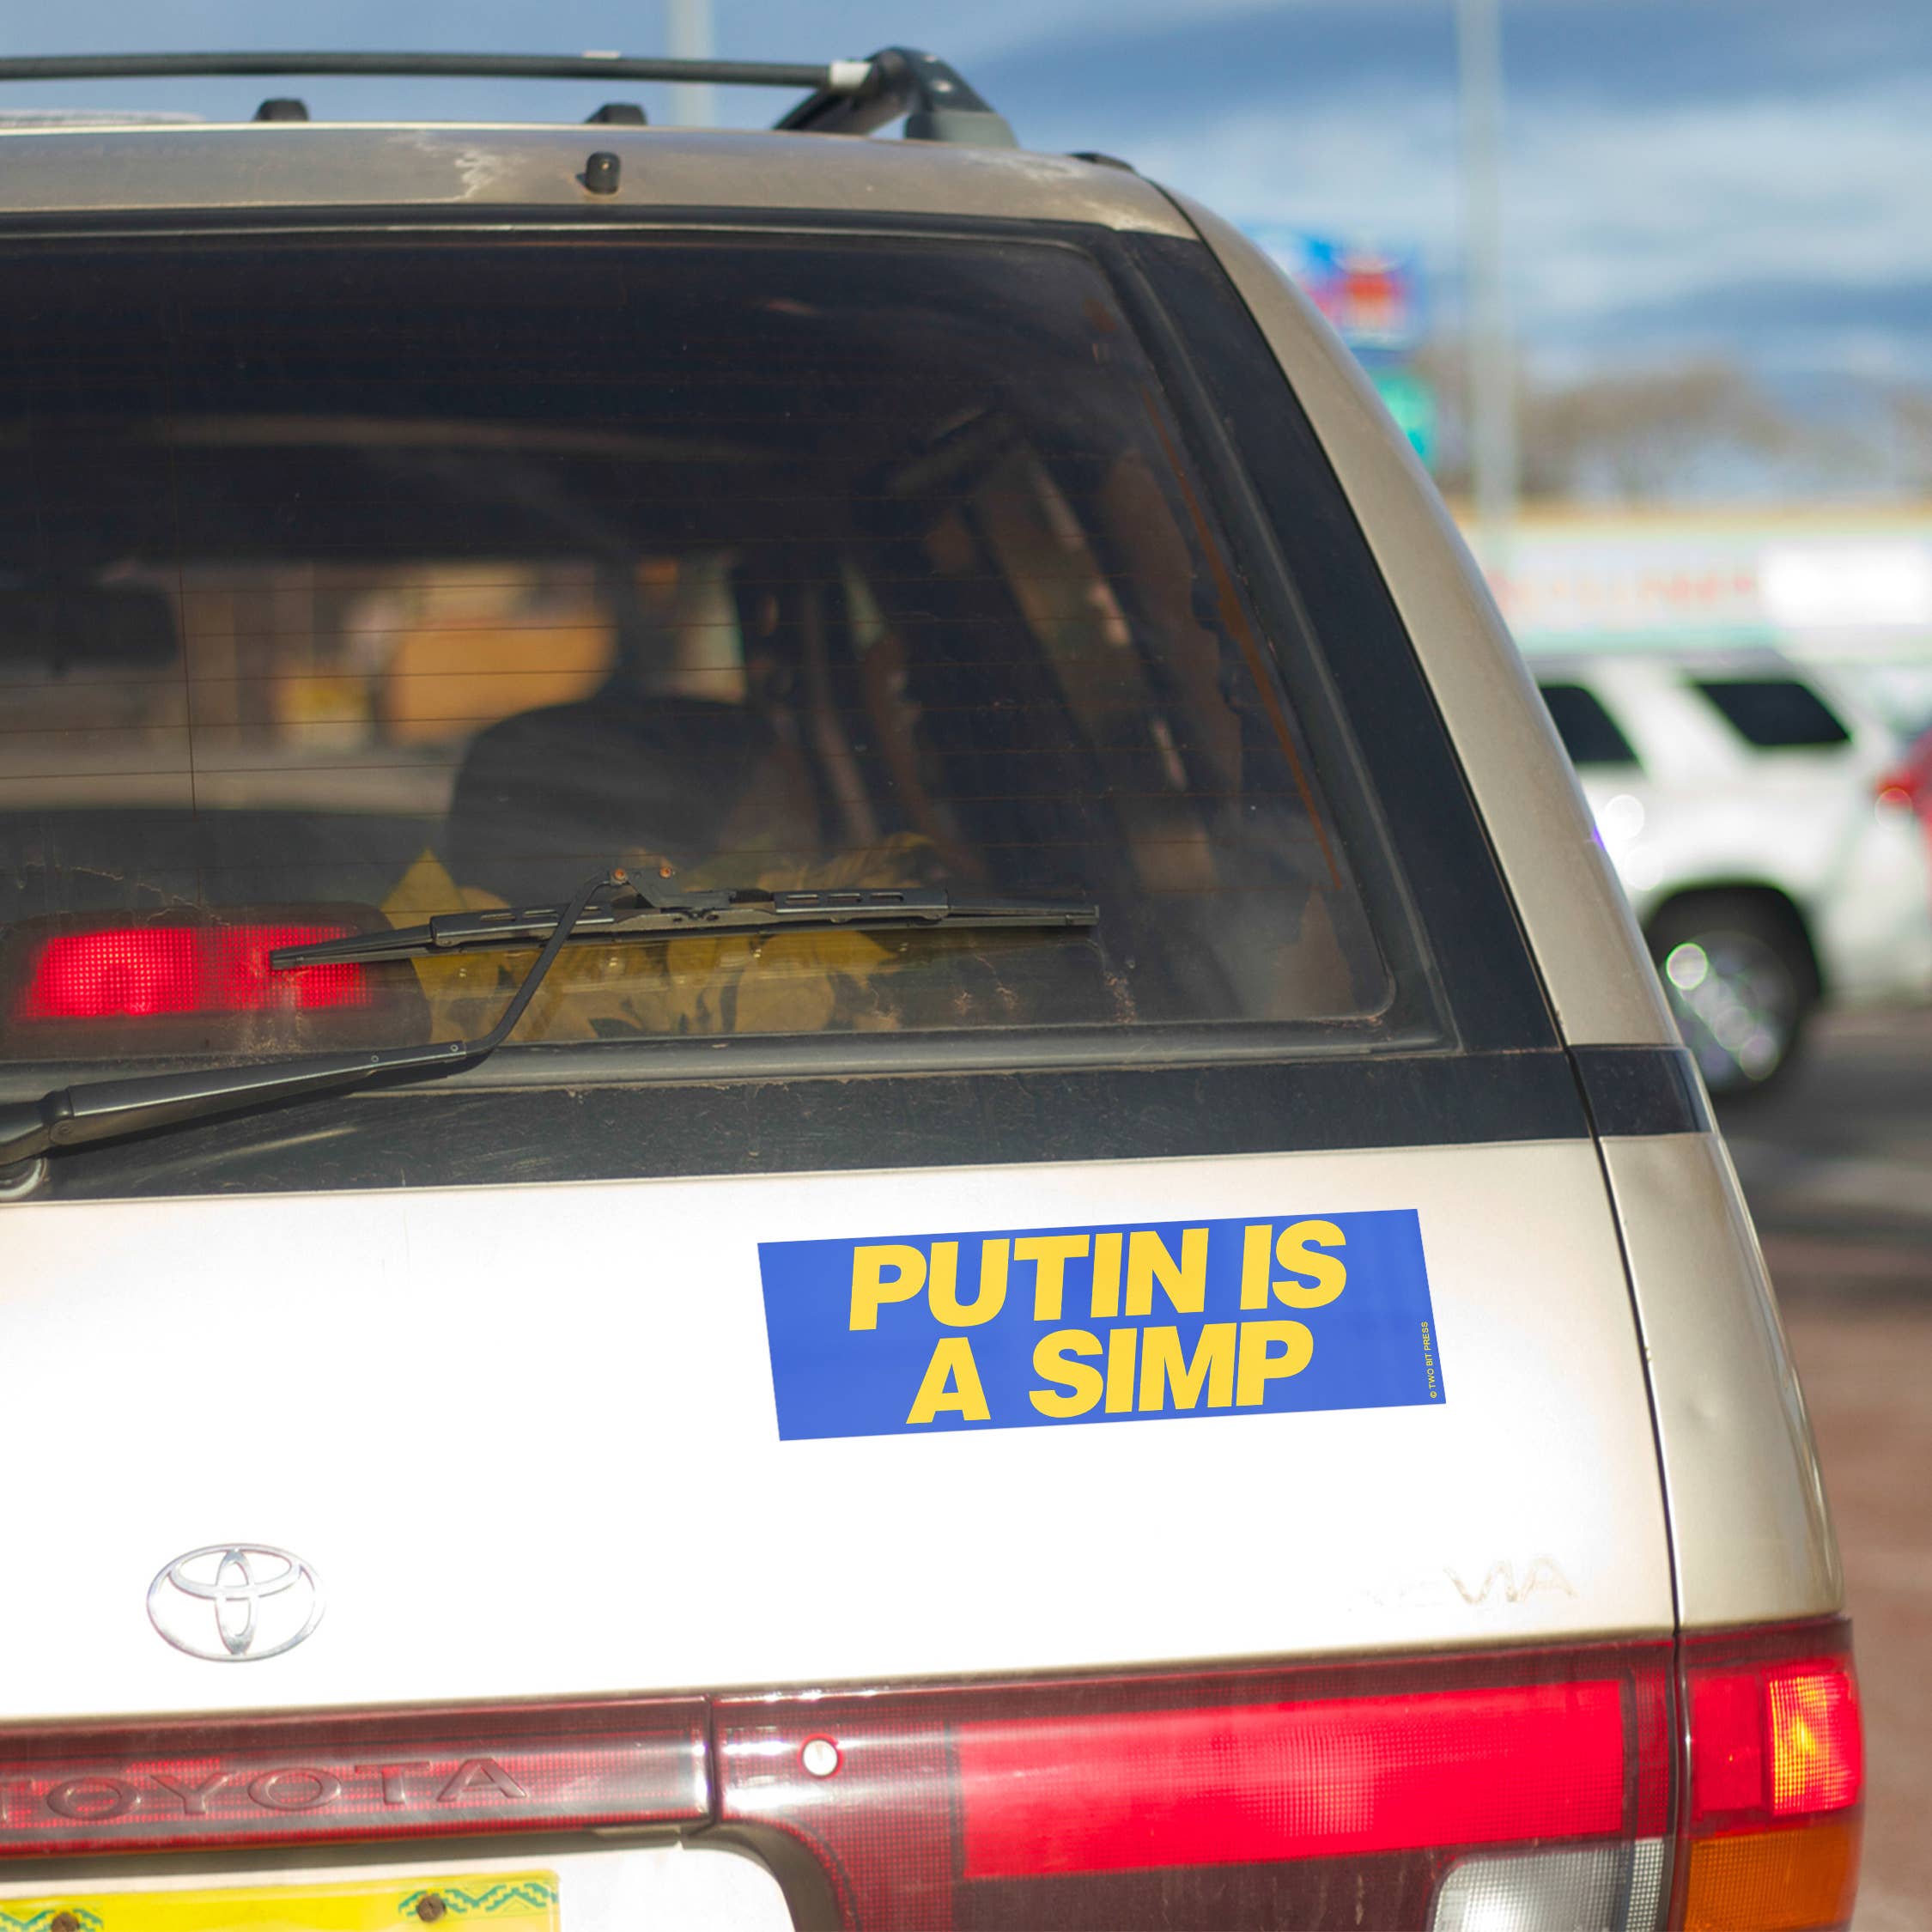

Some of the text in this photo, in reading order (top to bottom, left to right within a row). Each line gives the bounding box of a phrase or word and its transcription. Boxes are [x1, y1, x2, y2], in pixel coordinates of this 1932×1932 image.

[849, 1220, 1347, 1331] PUTIN IS
[1421, 1321, 1431, 1351] PRESS
[906, 1320, 1314, 1425] A SIMP
[1425, 1353, 1433, 1366] BIT
[1426, 1368, 1437, 1389] TWO
